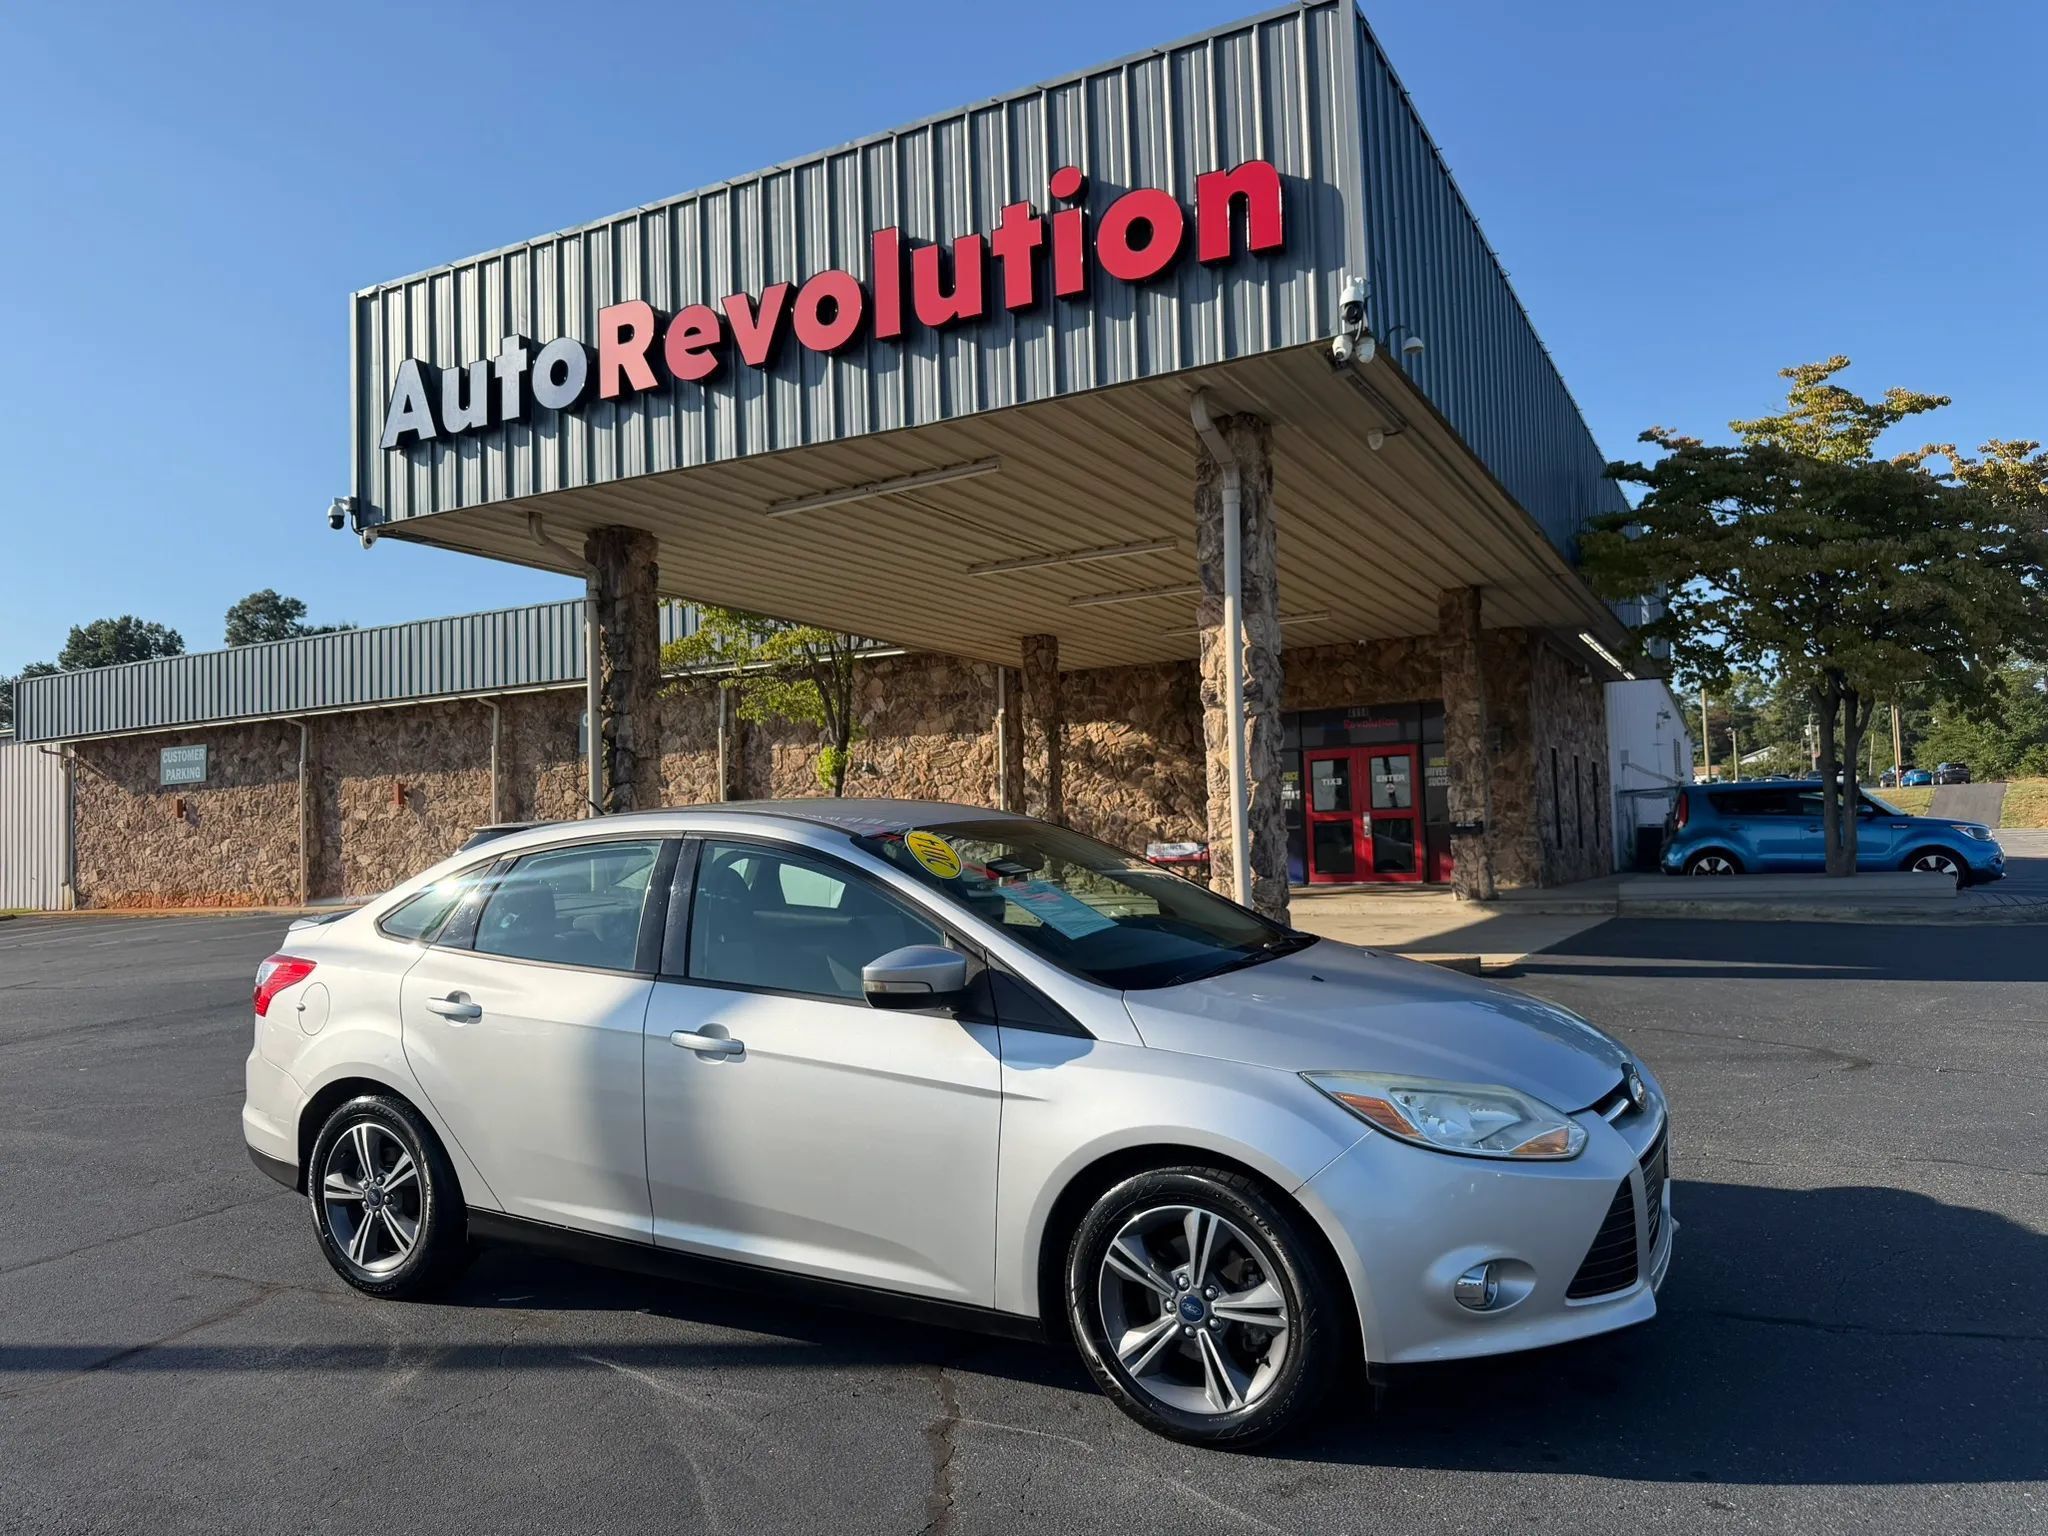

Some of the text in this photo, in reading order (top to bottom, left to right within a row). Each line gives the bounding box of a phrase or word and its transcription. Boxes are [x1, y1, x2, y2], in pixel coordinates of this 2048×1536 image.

[162, 749, 205, 763] CUSTOMER
[165, 767, 201, 781] PARKING
[1376, 774, 1406, 783] ENTER
[910, 835, 957, 871] 2014
